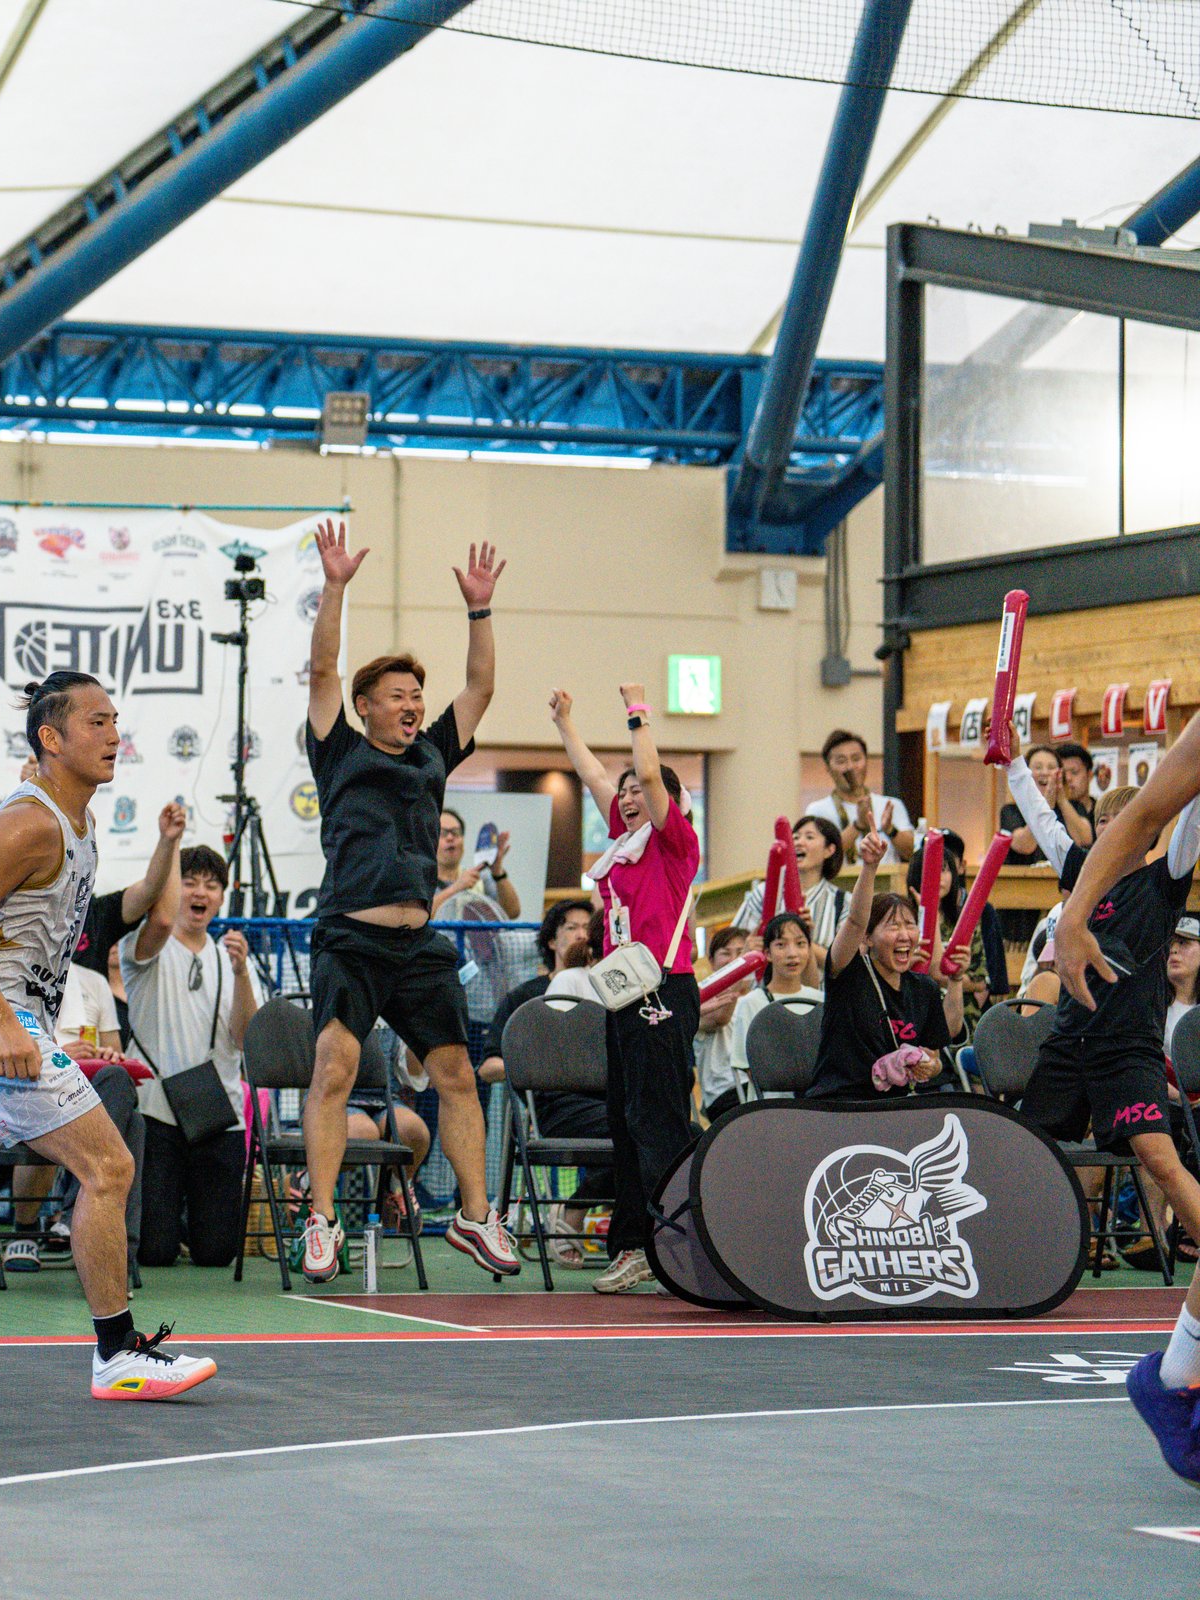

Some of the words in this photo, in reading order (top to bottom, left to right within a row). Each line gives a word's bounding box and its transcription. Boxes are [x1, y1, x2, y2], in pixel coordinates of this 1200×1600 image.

[1113, 1102, 1163, 1128] MSG
[836, 1213, 935, 1247] SHINOBI
[815, 1249, 968, 1288] GATHERS
[880, 1282, 911, 1292] MIE
